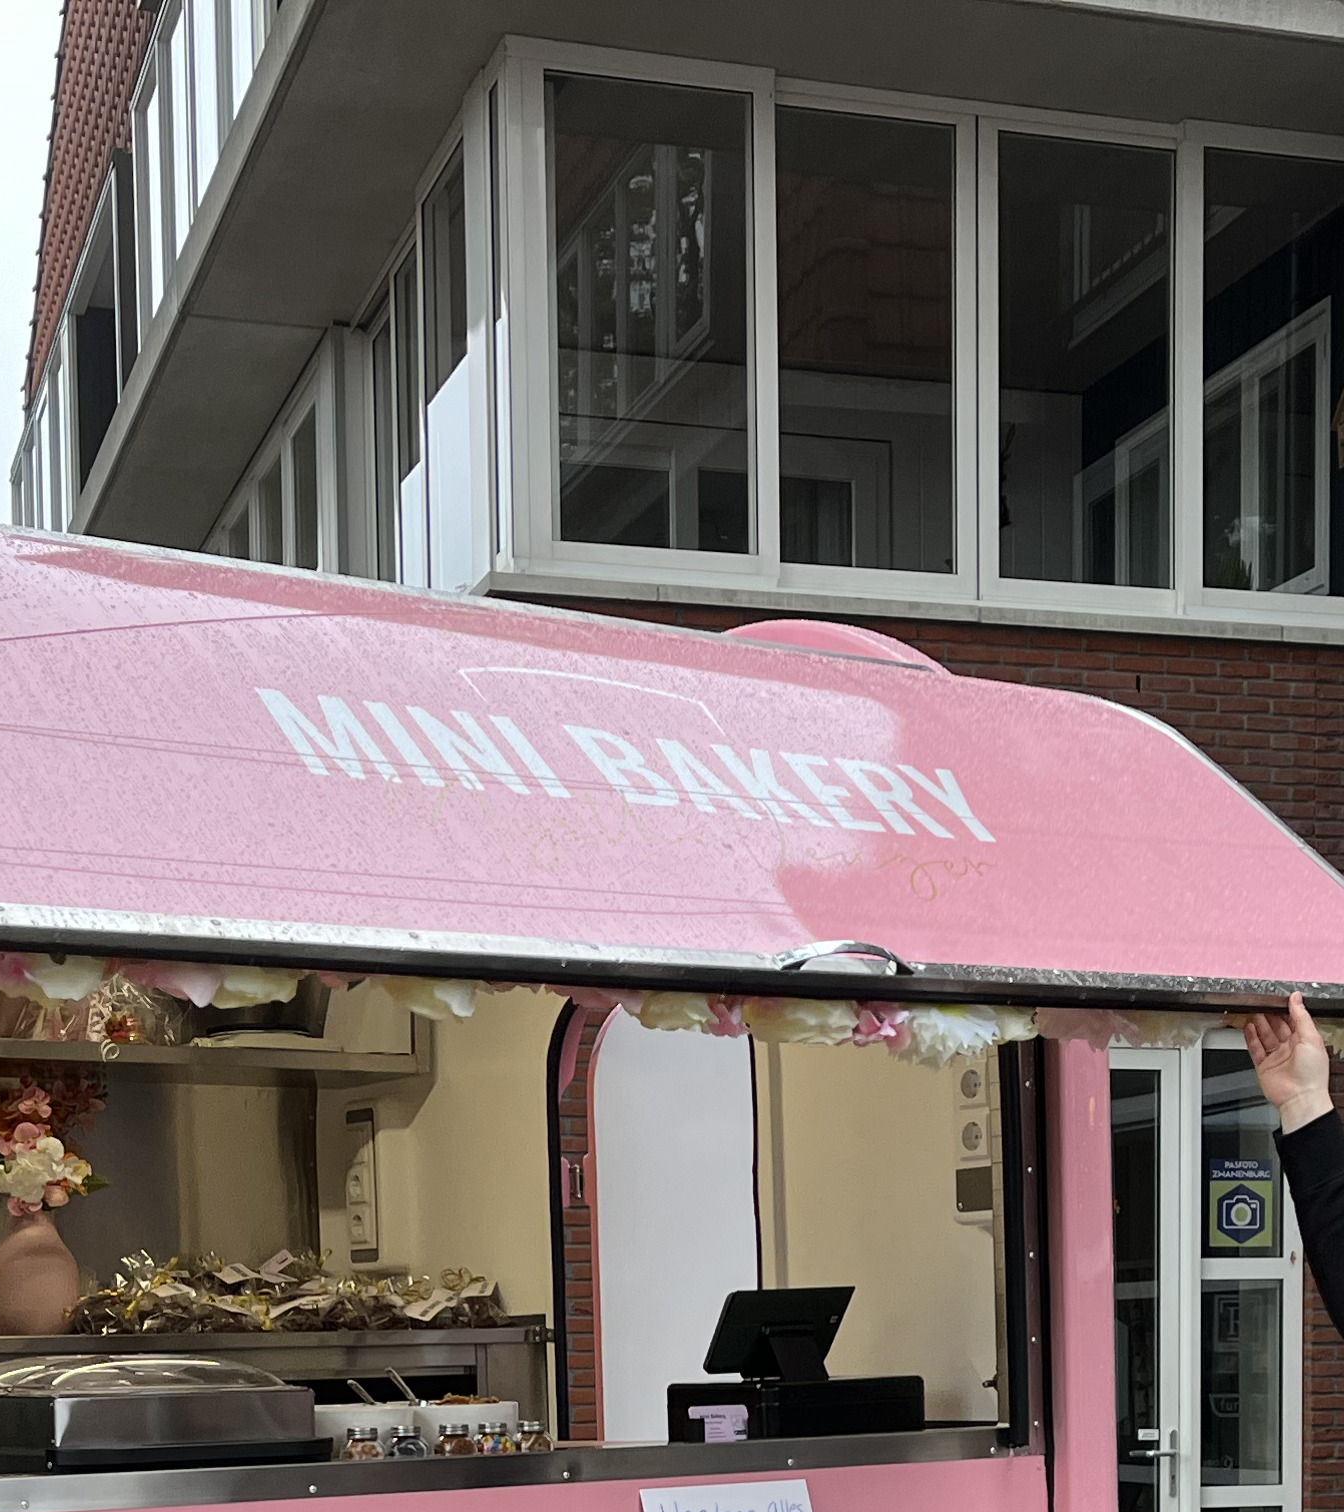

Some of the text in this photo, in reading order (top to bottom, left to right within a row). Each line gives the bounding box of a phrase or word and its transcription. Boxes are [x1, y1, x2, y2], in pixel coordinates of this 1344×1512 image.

[254, 686, 997, 844] MINI BAKERY
[1224, 1160, 1259, 1169] PASFOTO
